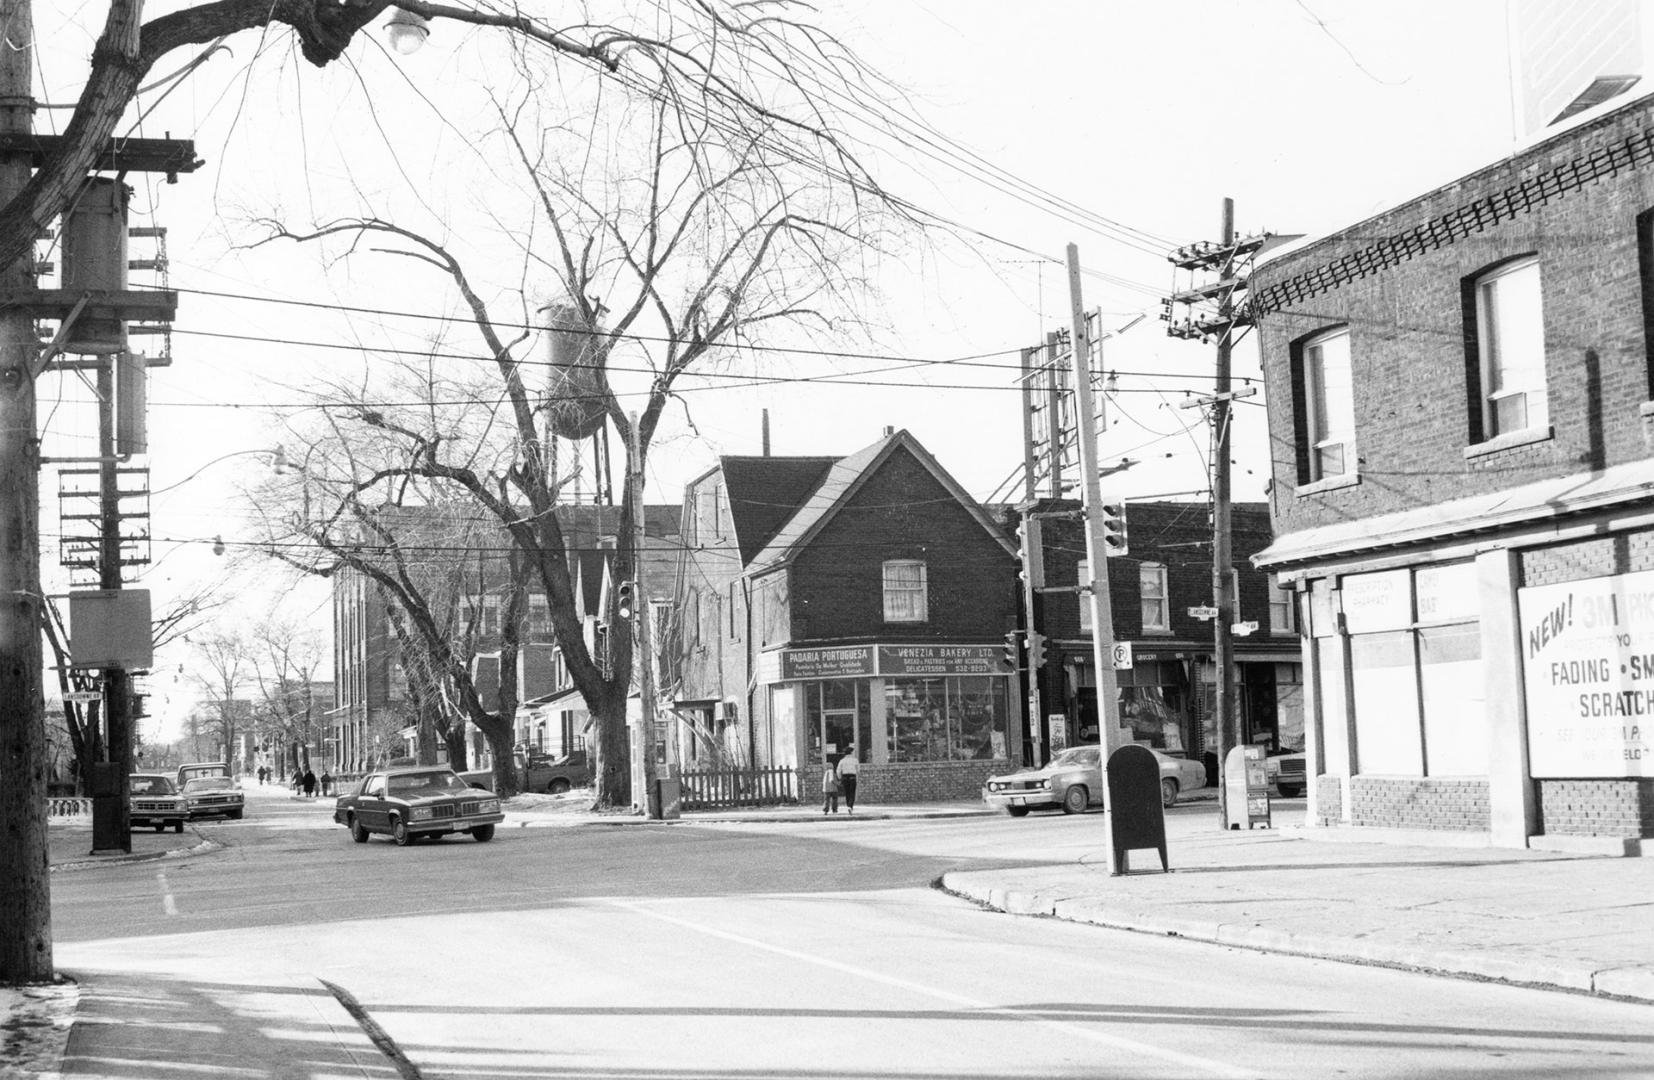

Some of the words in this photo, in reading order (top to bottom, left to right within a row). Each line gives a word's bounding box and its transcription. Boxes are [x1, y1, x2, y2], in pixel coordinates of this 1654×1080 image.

[1529, 593, 1573, 660] NEW!
[822, 648, 867, 661] PORTUGUESA
[940, 648, 971, 657] BAKERY
[1551, 658, 1609, 686] FADING
